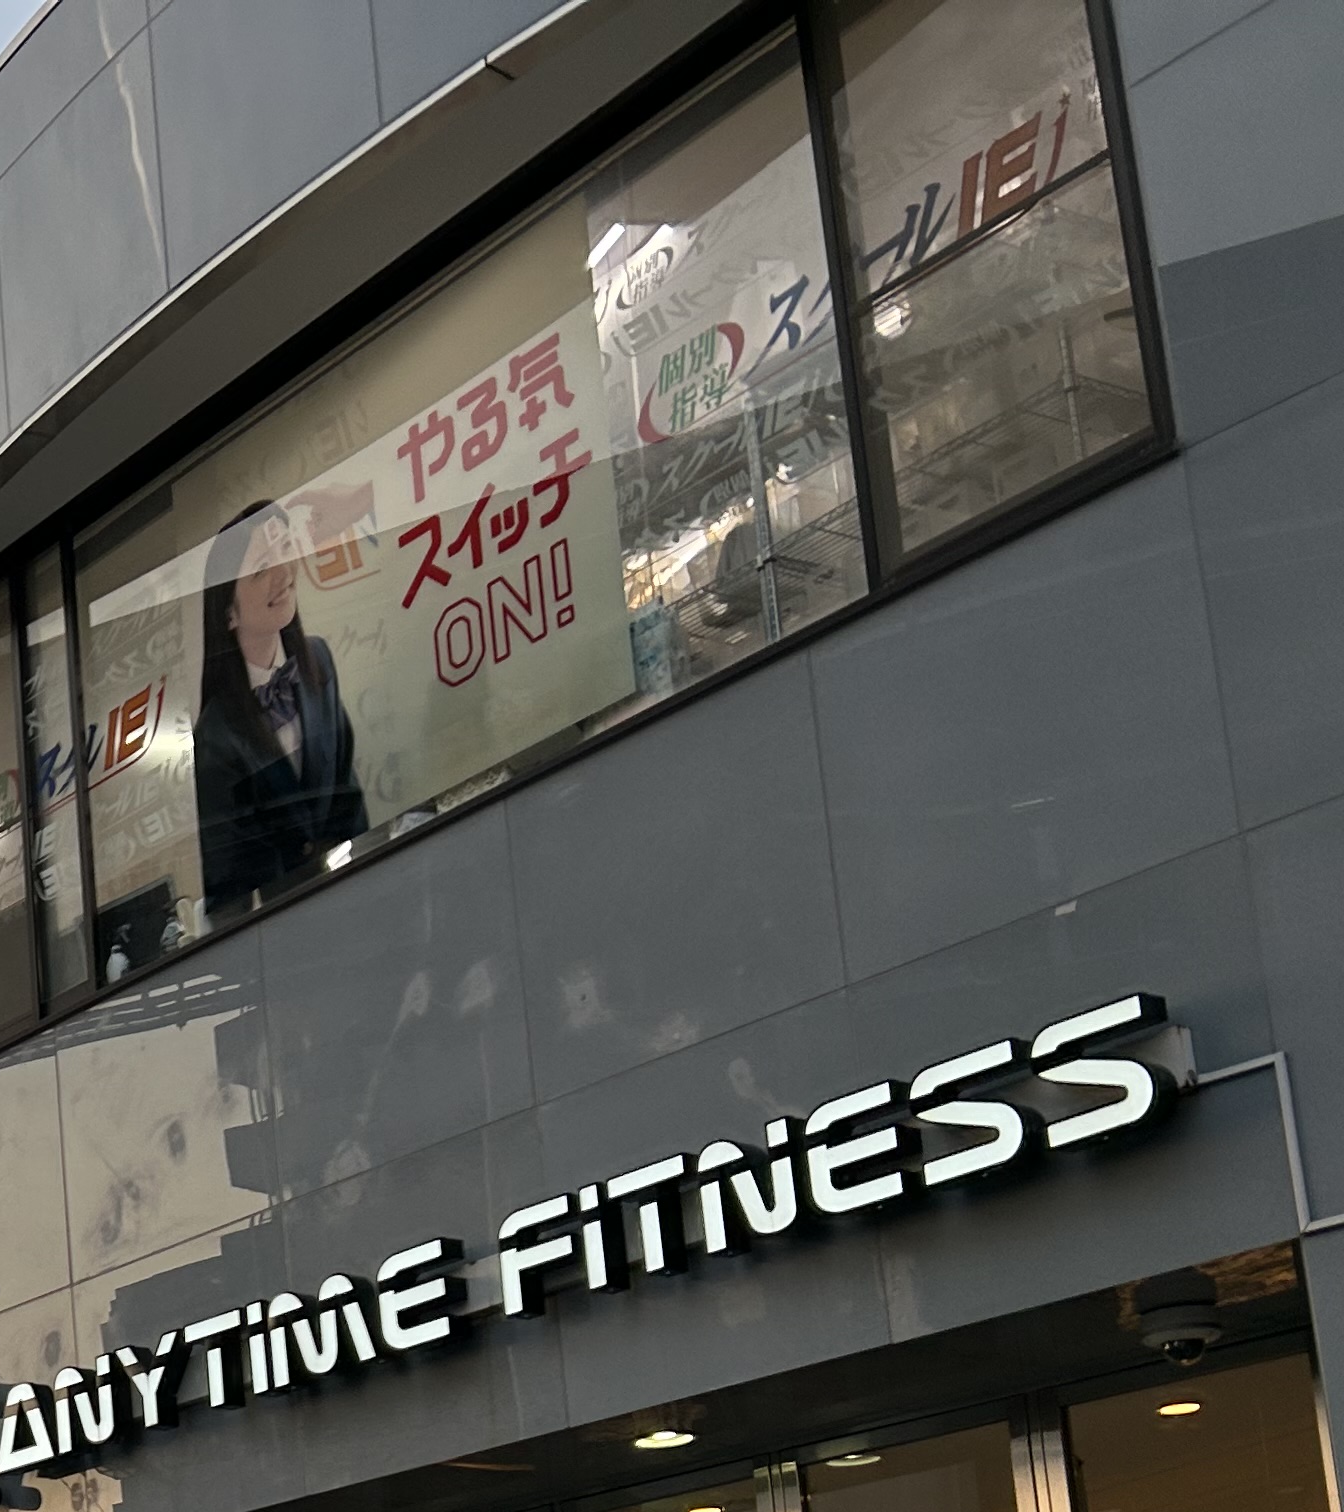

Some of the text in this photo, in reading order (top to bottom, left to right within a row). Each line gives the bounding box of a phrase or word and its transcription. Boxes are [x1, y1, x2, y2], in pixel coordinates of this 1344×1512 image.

[398, 333, 575, 503] やる気
[659, 322, 718, 396] 個別
[668, 362, 731, 433] 指導
[398, 428, 593, 609] スイッチ
[434, 538, 575, 688] ON!
[499, 994, 1154, 1316] FITNESS
